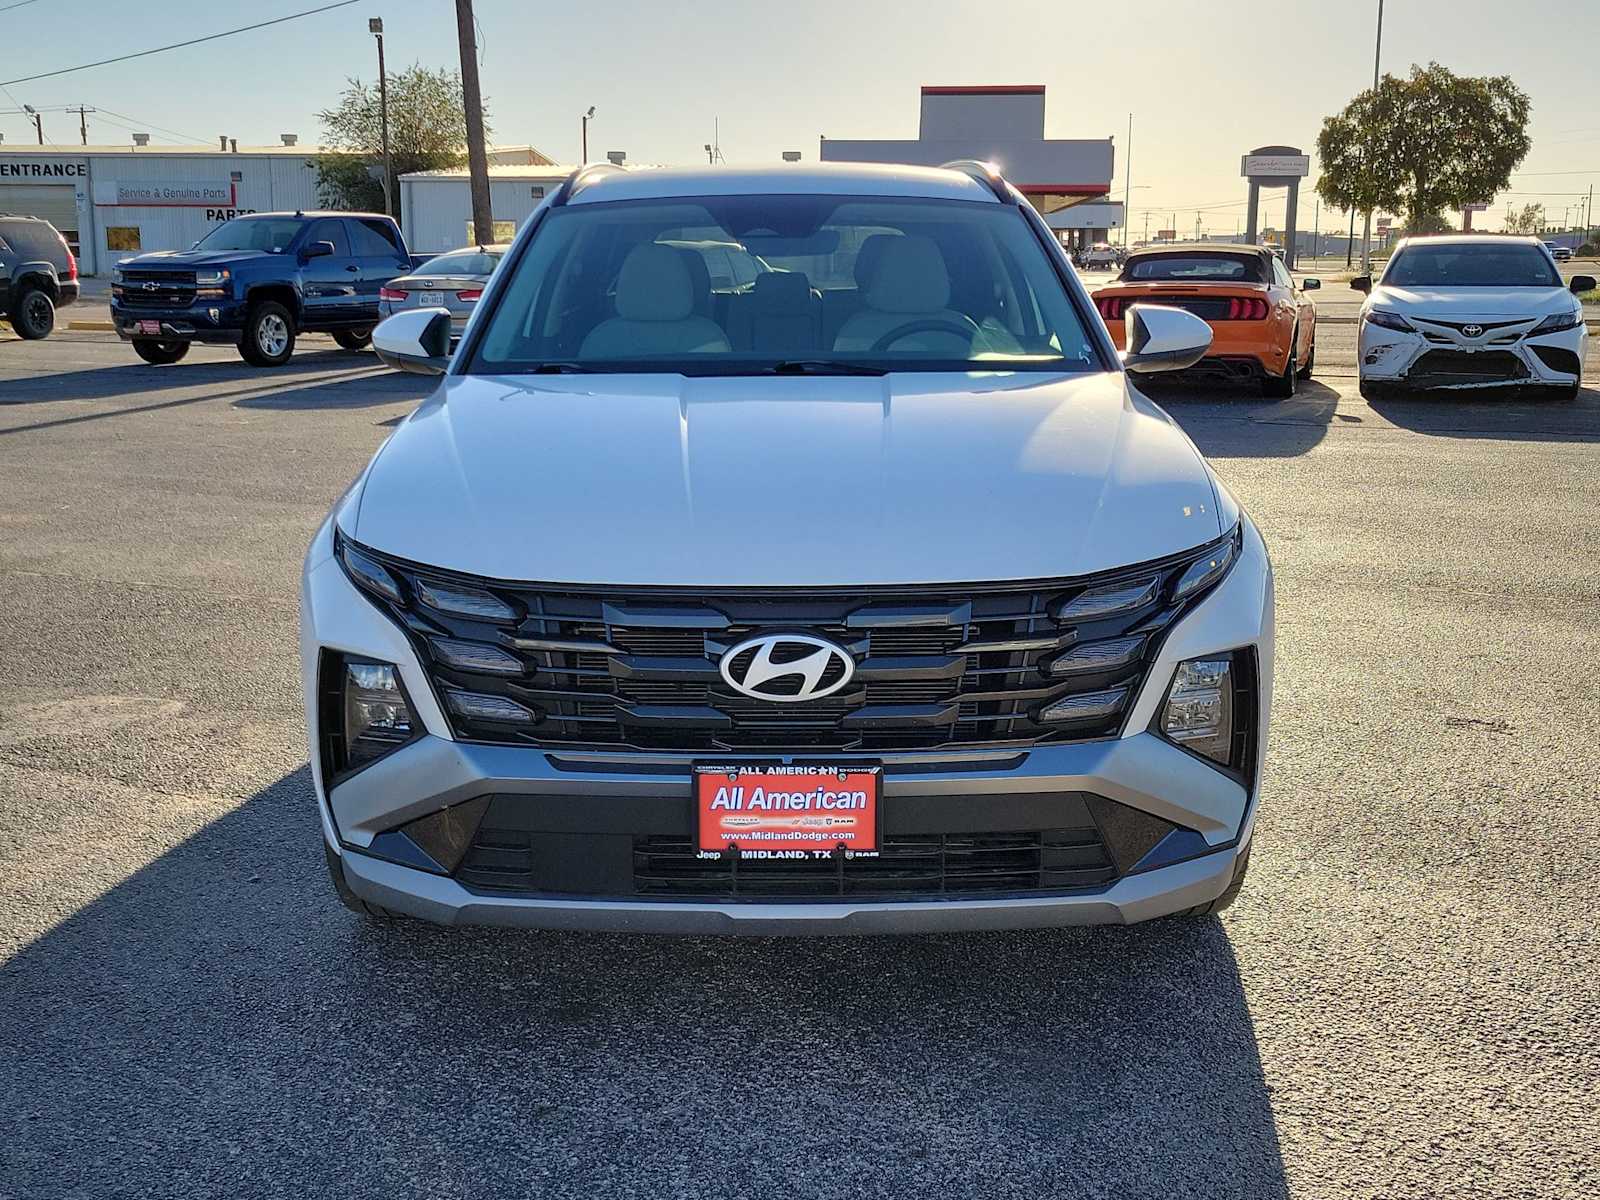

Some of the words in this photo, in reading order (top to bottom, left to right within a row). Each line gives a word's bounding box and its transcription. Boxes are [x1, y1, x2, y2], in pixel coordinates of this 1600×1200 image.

[0, 164, 87, 176] ENTRANCE
[119, 188, 150, 198] Service
[154, 189, 160, 198] &
[163, 188, 200, 198] Genuine
[203, 188, 226, 198] Parts
[739, 766, 763, 775] ALL
[711, 787, 744, 810] All
[748, 786, 867, 810] American
[720, 831, 855, 841] www.MidlandDodge.com
[696, 850, 721, 860] Jeep
[741, 850, 809, 860] MIDLAND,
[812, 850, 832, 859] TX
